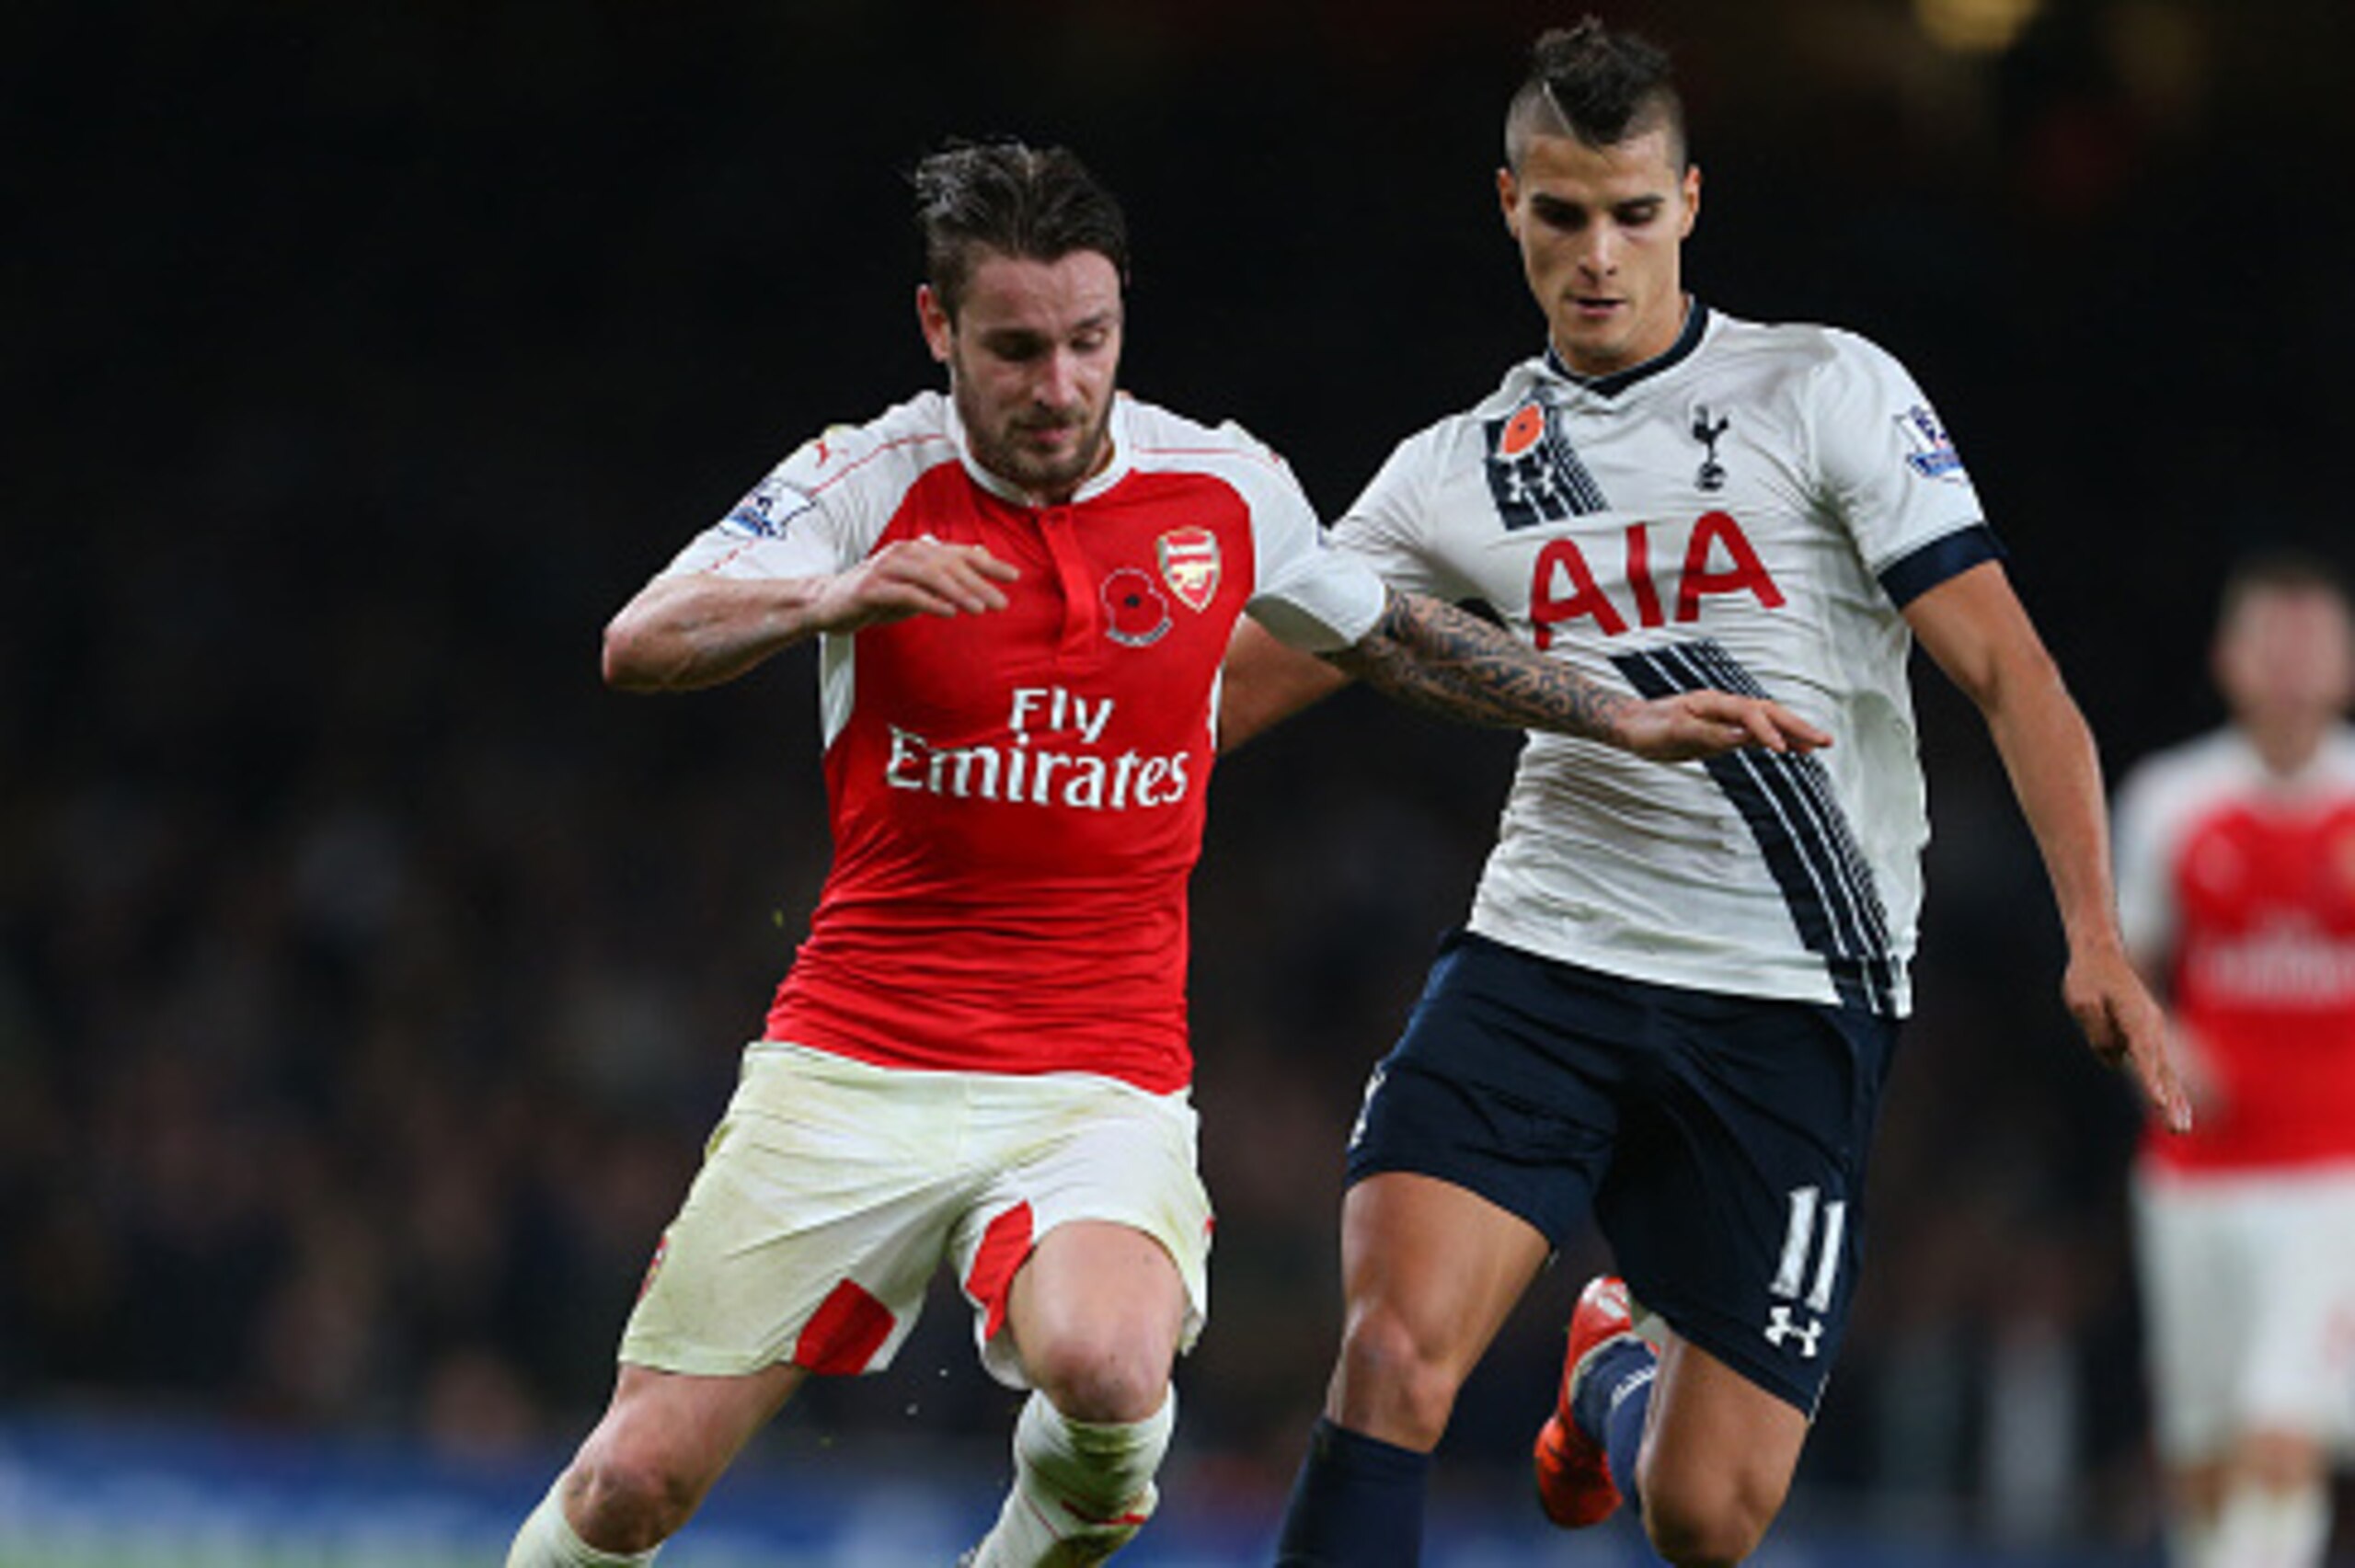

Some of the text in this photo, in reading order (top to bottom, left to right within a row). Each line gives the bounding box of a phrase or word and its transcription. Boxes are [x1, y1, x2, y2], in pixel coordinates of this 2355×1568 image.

[1530, 510, 1786, 649] AIA
[1010, 687, 1114, 742] Fly
[887, 727, 1189, 809] Emirates
[1770, 1186, 1845, 1312] 11
